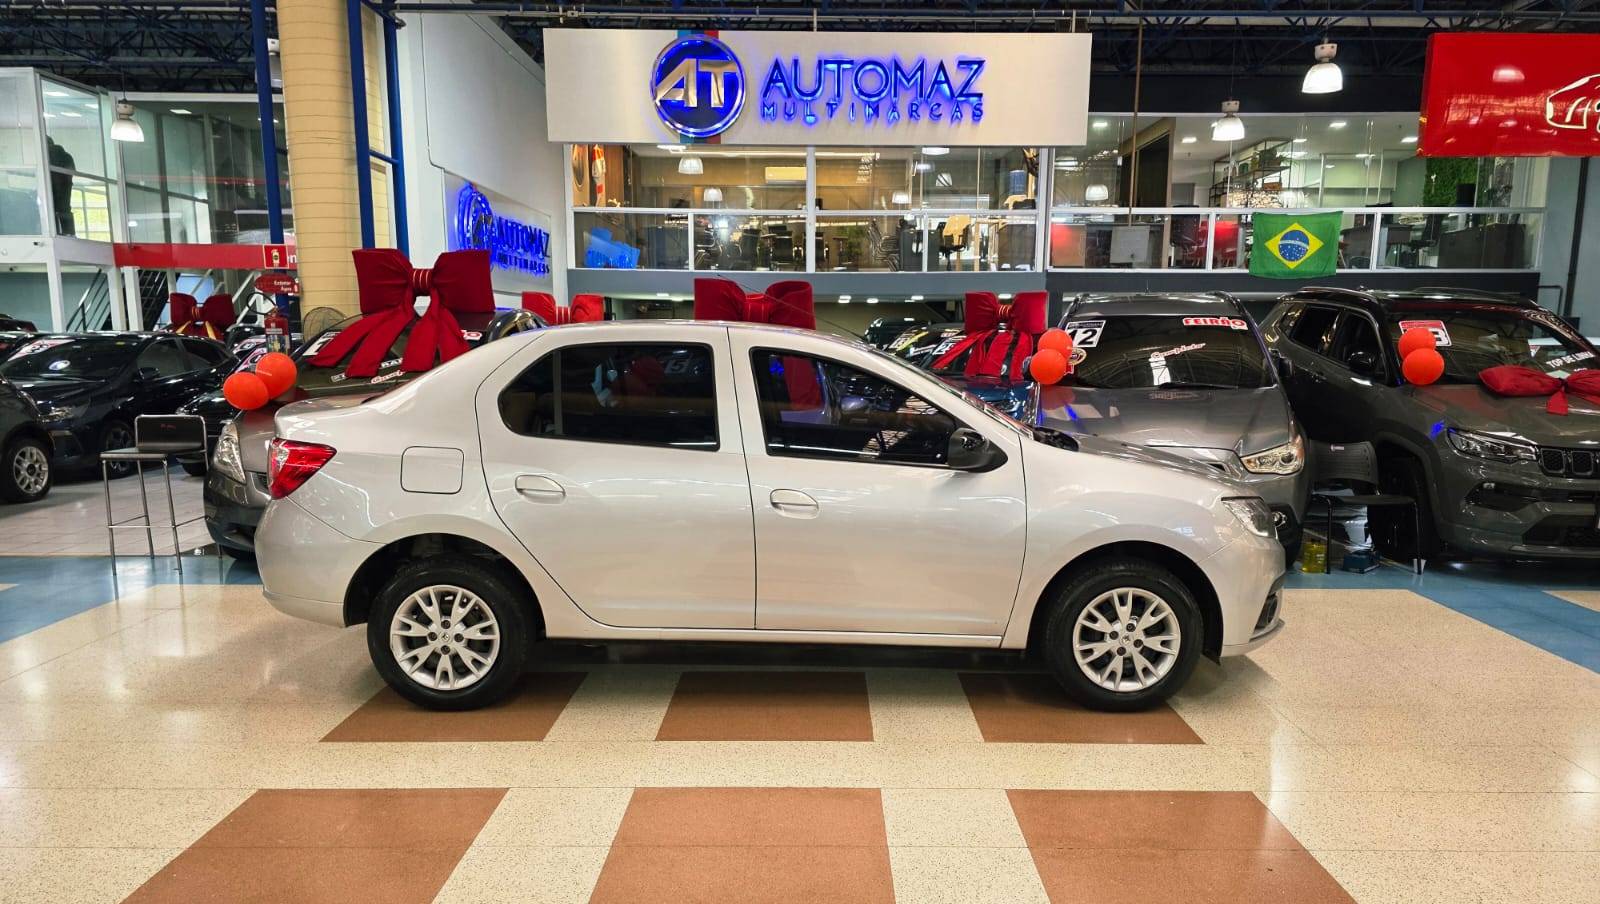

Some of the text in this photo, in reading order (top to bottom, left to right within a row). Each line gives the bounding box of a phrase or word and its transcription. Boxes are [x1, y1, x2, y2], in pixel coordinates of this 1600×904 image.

[655, 58, 737, 108] AT
[762, 58, 986, 100] AUTOMAZ
[761, 101, 985, 121] MULTIMARCAS
[1183, 317, 1246, 328] FEIRÃO
[1069, 328, 1098, 346] 12
[1545, 358, 1563, 368] TOP
